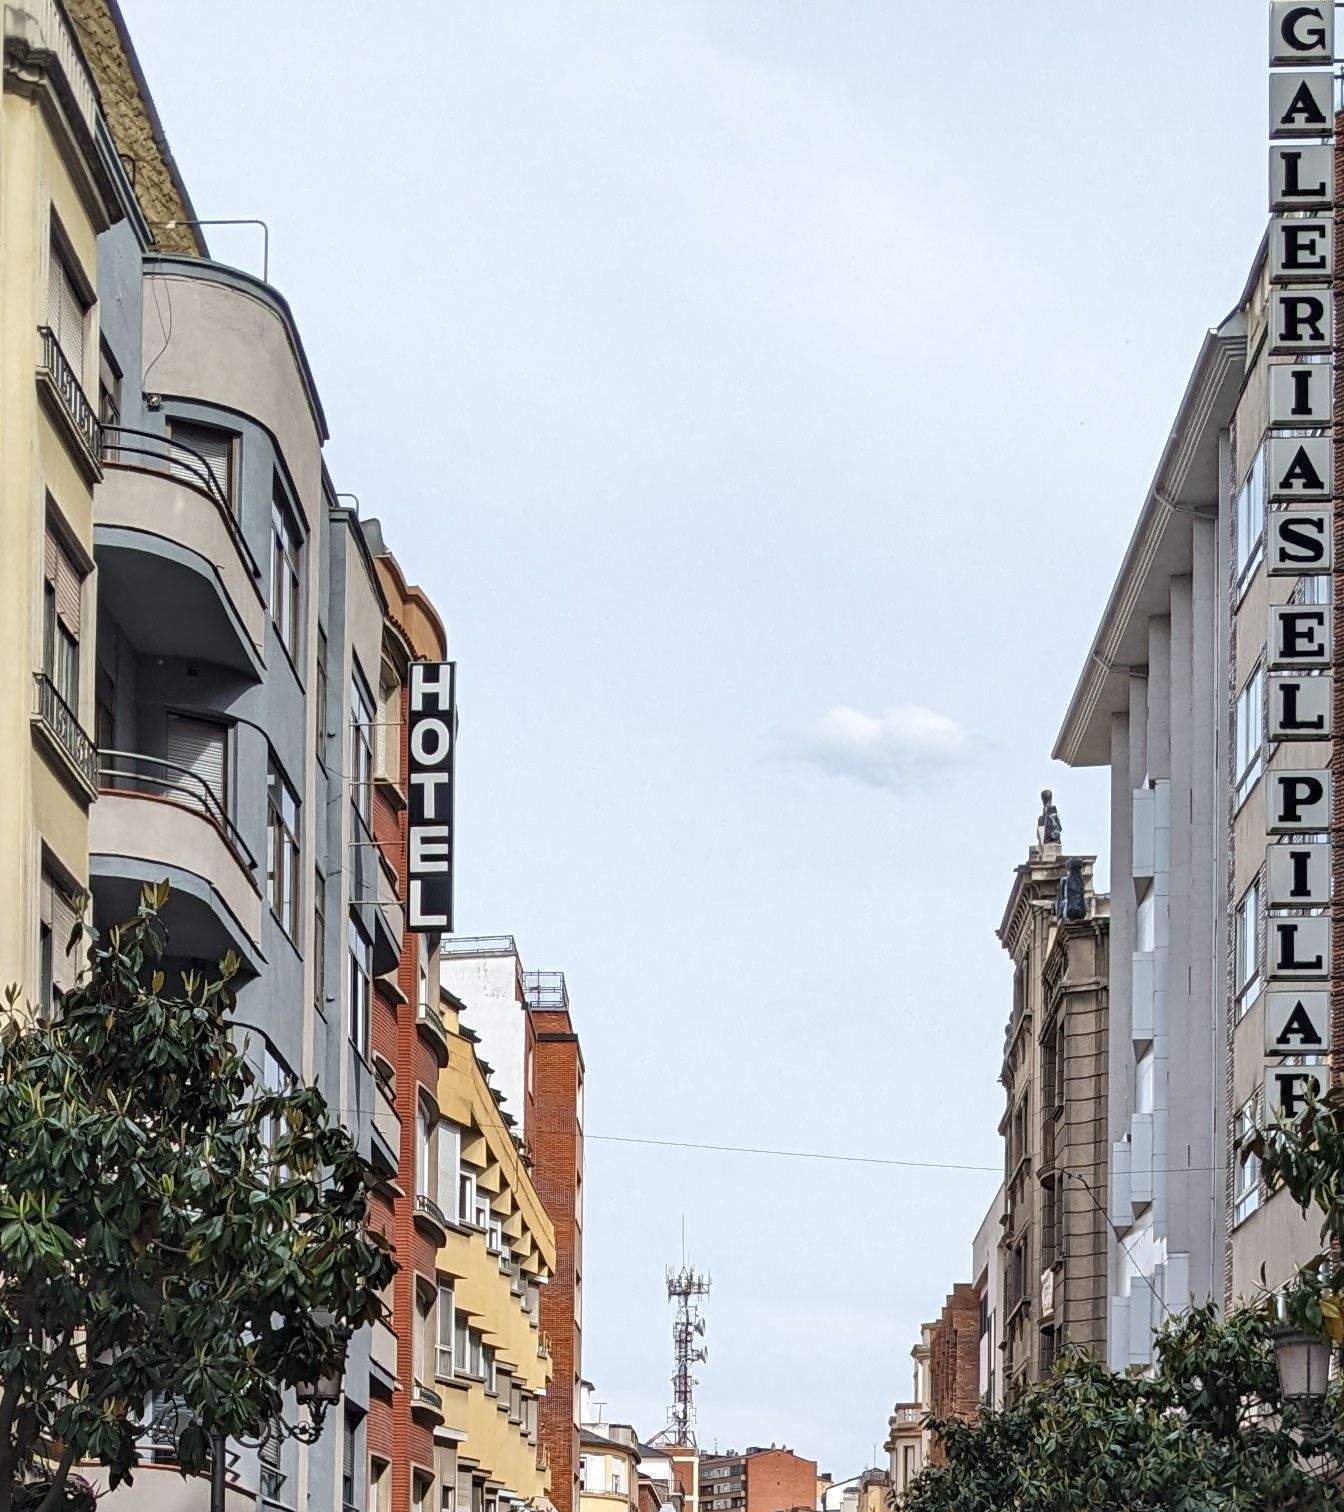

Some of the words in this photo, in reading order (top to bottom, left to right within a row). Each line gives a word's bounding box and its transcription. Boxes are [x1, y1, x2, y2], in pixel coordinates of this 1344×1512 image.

[1278, 6, 1327, 563] GALERIAS
[408, 665, 450, 926] HOTEL
[1277, 612, 1325, 731] EL
